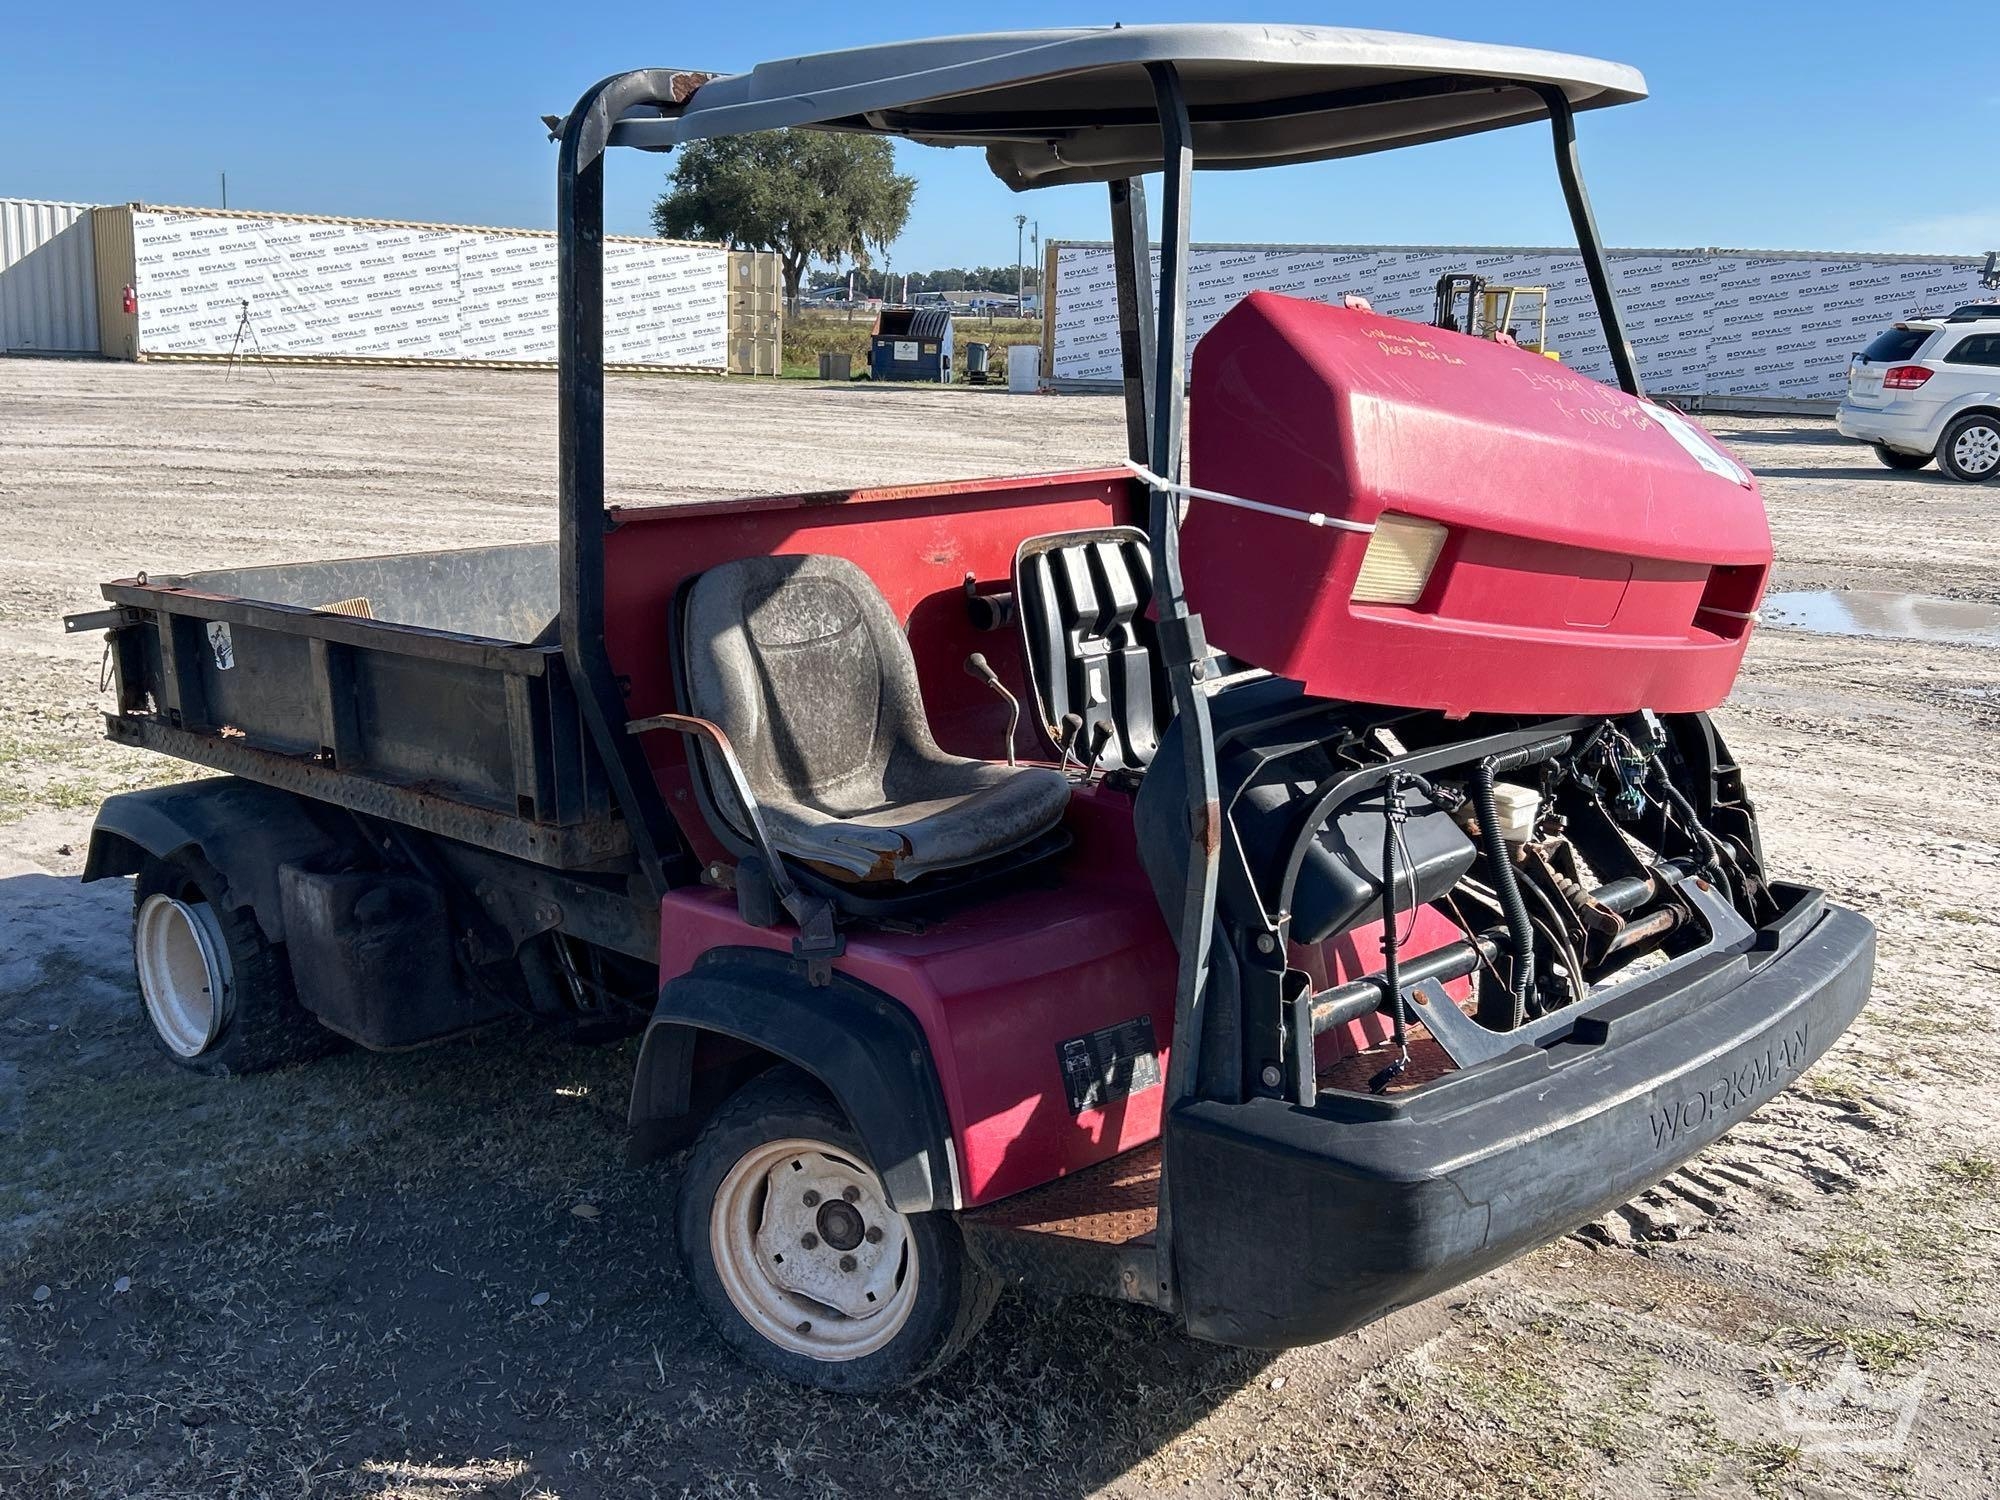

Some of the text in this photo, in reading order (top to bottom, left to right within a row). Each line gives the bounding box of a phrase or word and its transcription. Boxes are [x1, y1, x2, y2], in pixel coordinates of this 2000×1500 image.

[402, 251, 429, 259] ROYAL
[1220, 257, 1248, 265] ROYAL
[1476, 257, 1506, 265] ROYAL
[1671, 259, 1702, 267] ROYAL
[1287, 262, 1316, 271] ROYAL
[1429, 265, 1458, 273] ROYAL
[1821, 264, 1853, 272] ROYAL
[1064, 268, 1091, 276] ROYAL
[1242, 270, 1271, 279] ROYAL
[1503, 270, 1533, 278] ROYAL
[1623, 267, 1653, 275] ROYAL
[1900, 270, 1932, 278] ROYAL
[1314, 275, 1343, 283] ROYAL
[1770, 272, 1802, 280] ROYAL
[1089, 281, 1116, 289] ROYAL
[1198, 278, 1226, 286] ROYAL
[1651, 280, 1681, 289] ROYAL
[1721, 279, 1751, 287] ROYAL
[1849, 278, 1881, 286] ROYAL
[181, 284, 210, 292] ROYAL
[1269, 283, 1297, 291] ROYAL
[1798, 285, 1830, 294] ROYAL
[1926, 284, 1958, 292] ROYAL
[1554, 296, 1584, 304] ROYAL
[1748, 293, 1780, 301] ROYAL
[1874, 292, 1906, 300] ROYAL
[206, 298, 236, 306] ROYAL
[1627, 302, 1657, 310] ROYAL
[1823, 300, 1855, 308] ROYAL
[1773, 307, 1805, 315] ROYAL
[1654, 315, 1685, 323] ROYAL
[1724, 314, 1754, 322] ROYAL
[1851, 313, 1883, 321] ROYAL
[1801, 321, 1833, 329] ROYAL
[1679, 328, 1709, 336] ROYAL
[1752, 328, 1782, 336] ROYAL
[1630, 336, 1660, 344] ROYAL
[1826, 335, 1858, 343] ROYAL
[1775, 342, 1807, 350] ROYAL
[1098, 347, 1121, 355] ROYA
[1658, 349, 1688, 358] ROYAL
[1727, 349, 1757, 357] ROYAL
[1803, 356, 1835, 364] ROYAL
[1077, 367, 1104, 375] ROYAL
[1755, 363, 1785, 371] ROYAL
[1640, 371, 1664, 379] OYAL
[1779, 377, 1809, 385] ROYAL
[1661, 384, 1692, 392] ROYAL
[1730, 384, 1760, 393] ROYAL
[1649, 1023, 1809, 1150] WORKMAN
